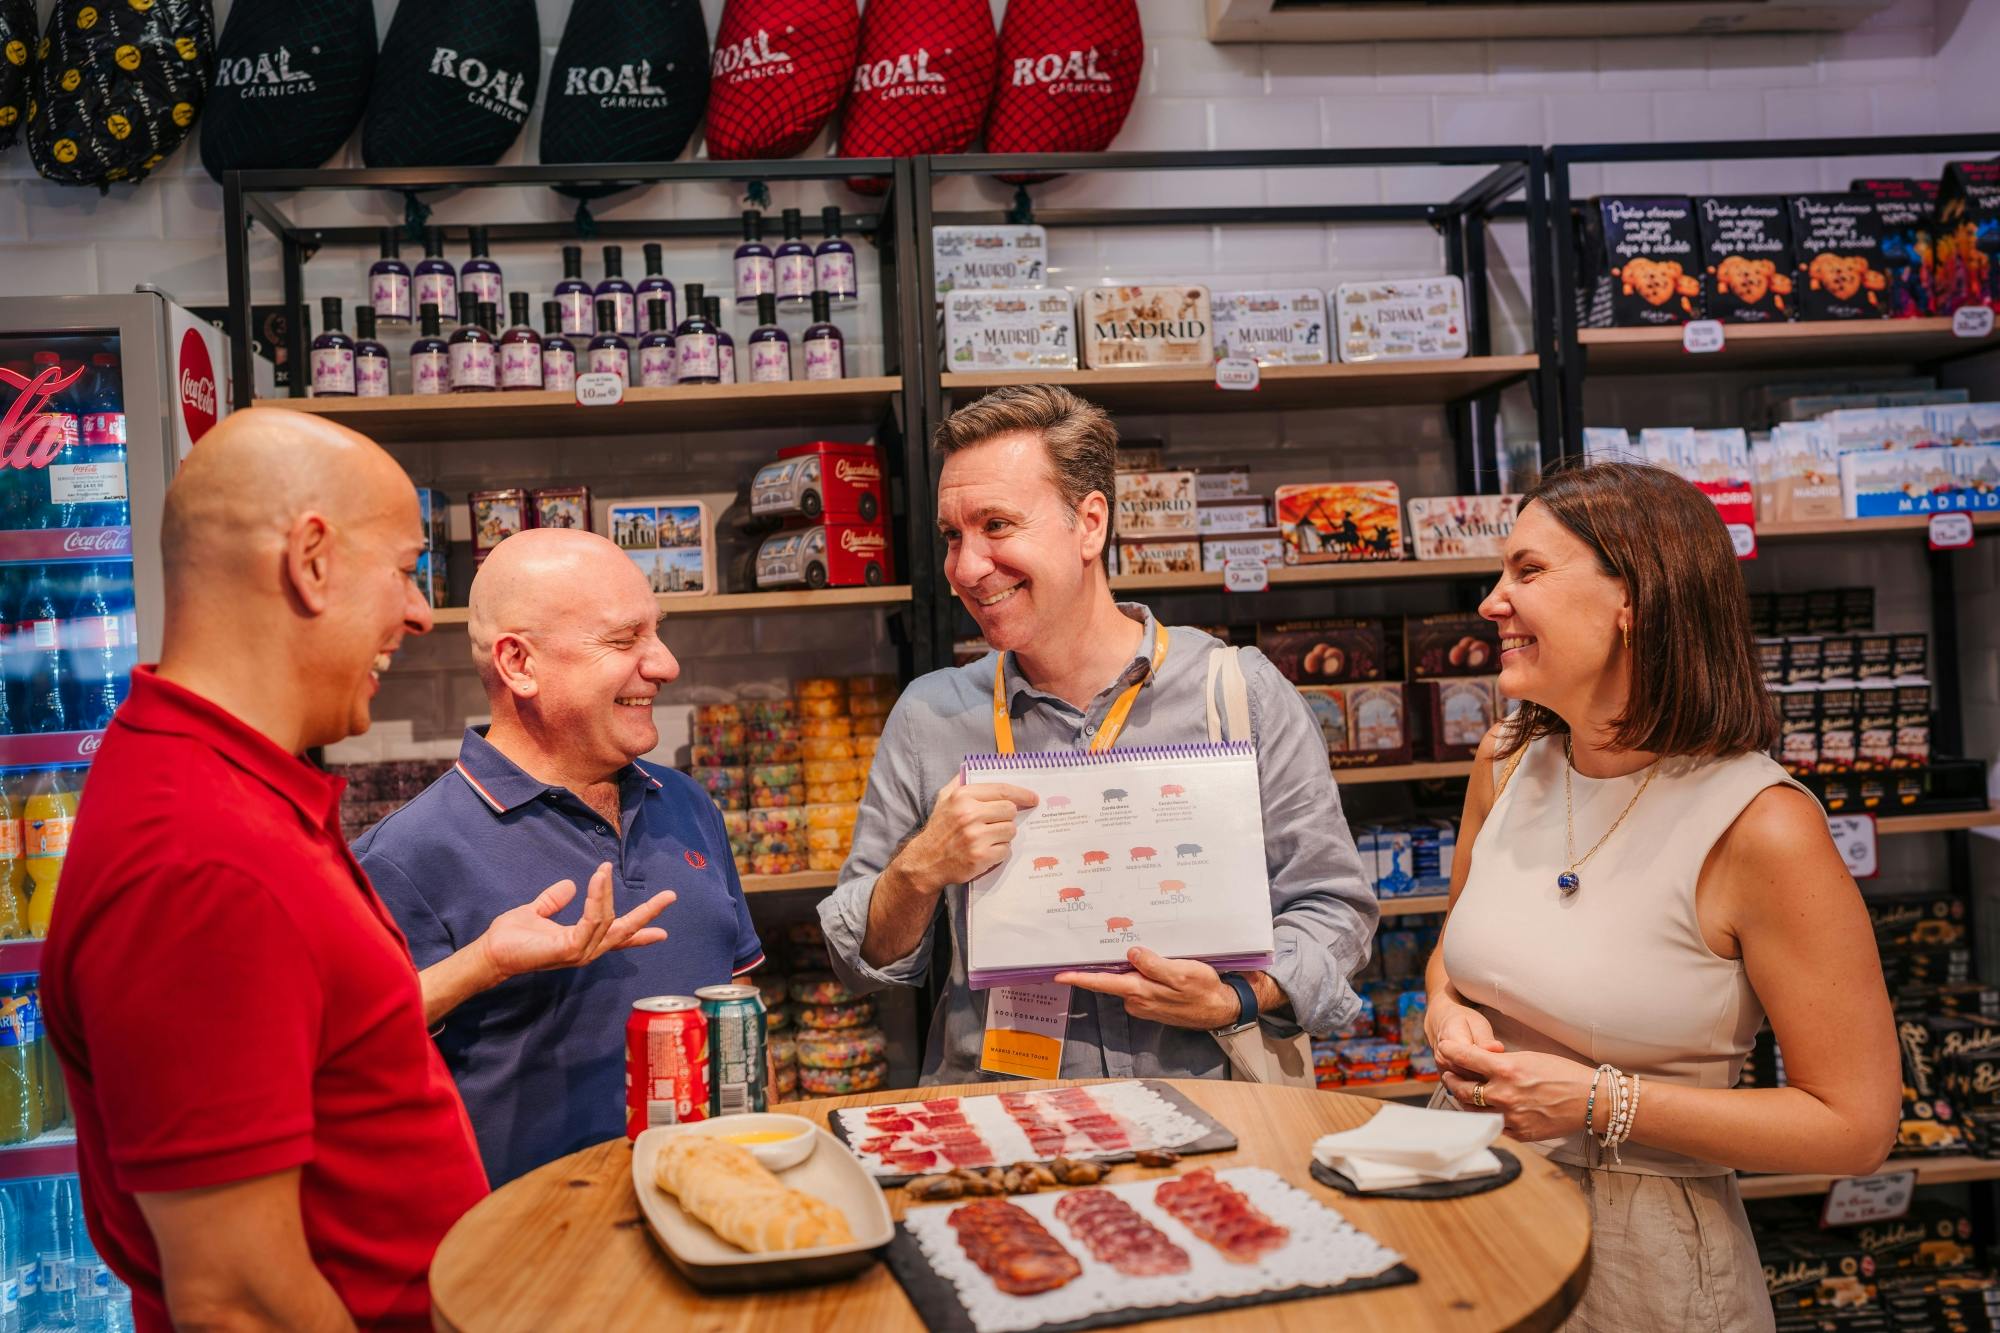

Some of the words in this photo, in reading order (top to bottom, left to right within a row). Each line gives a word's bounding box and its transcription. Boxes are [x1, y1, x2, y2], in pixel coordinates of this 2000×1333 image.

[711, 29, 791, 79] ROAL
[215, 46, 313, 87] ROAL
[853, 47, 945, 93] ROAL
[1011, 45, 1110, 87] ROAL
[429, 47, 528, 114] ROAL
[563, 58, 665, 96] ROAL
[964, 263, 1016, 279] MADRID
[984, 328, 1041, 346] MADRID
[1094, 320, 1206, 340] MADRID
[181, 366, 216, 417] Coca-Cola
[1119, 499, 1192, 513] MADRID
[1897, 494, 1999, 513] MADRID
[64, 531, 128, 551] Coca-Cola
[1067, 901, 1094, 912] 100%
[1170, 893, 1193, 905] 50%
[1120, 931, 1141, 943] 75%
